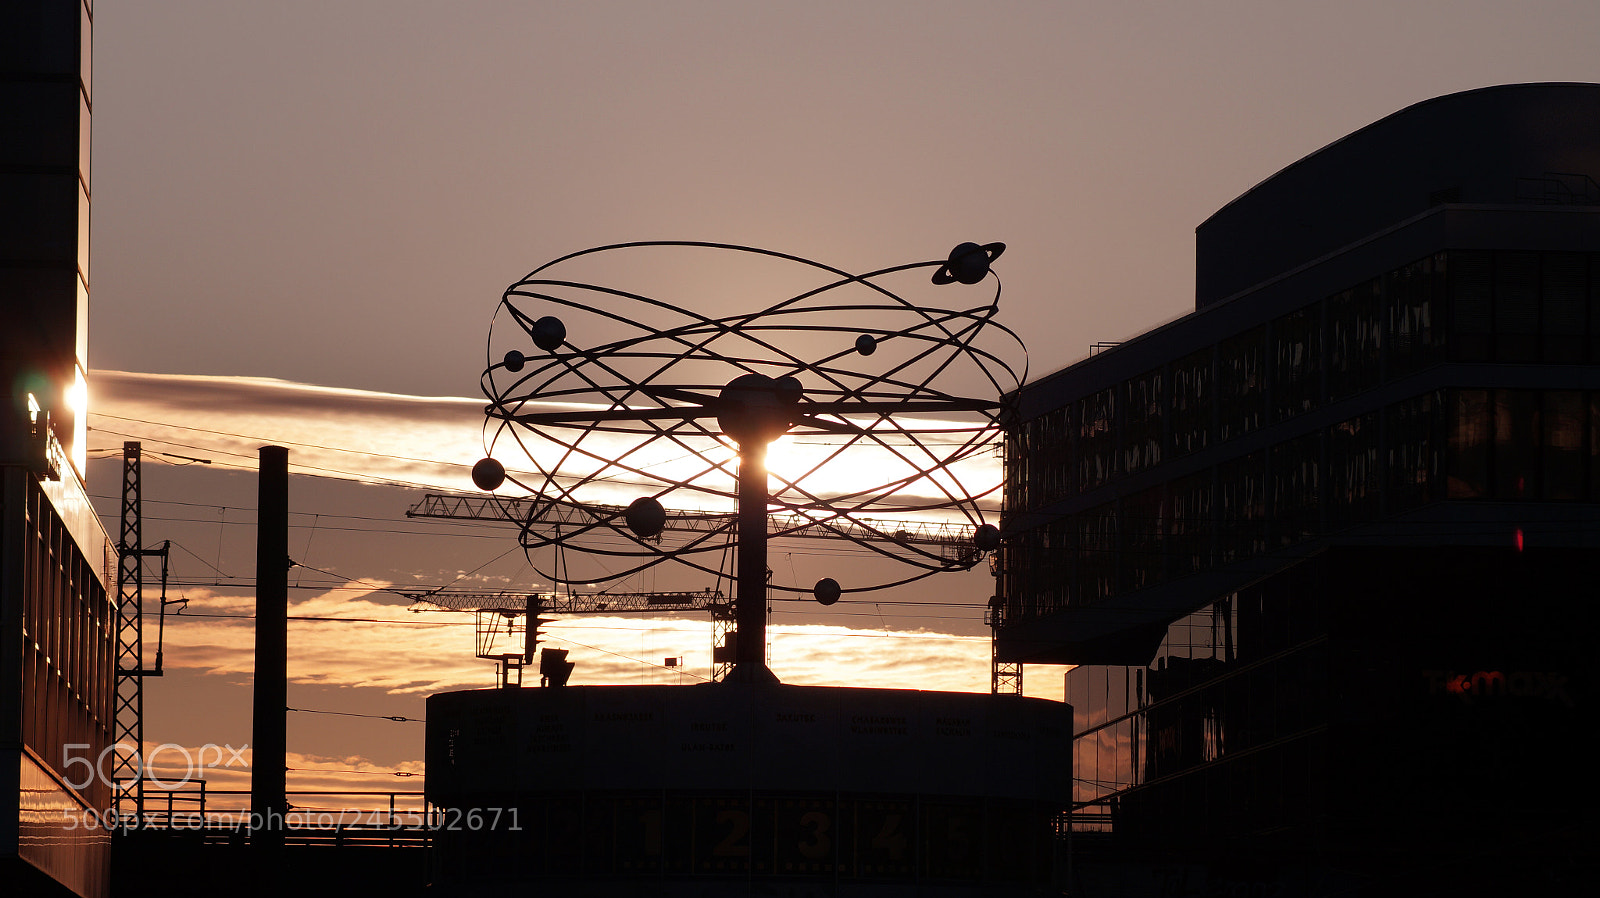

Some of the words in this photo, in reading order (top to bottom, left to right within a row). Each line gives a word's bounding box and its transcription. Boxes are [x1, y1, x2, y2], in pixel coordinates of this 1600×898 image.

[639, 809, 662, 857] 1
[712, 809, 751, 857] 2
[797, 811, 832, 860] 3
[871, 813, 908, 861] 4
